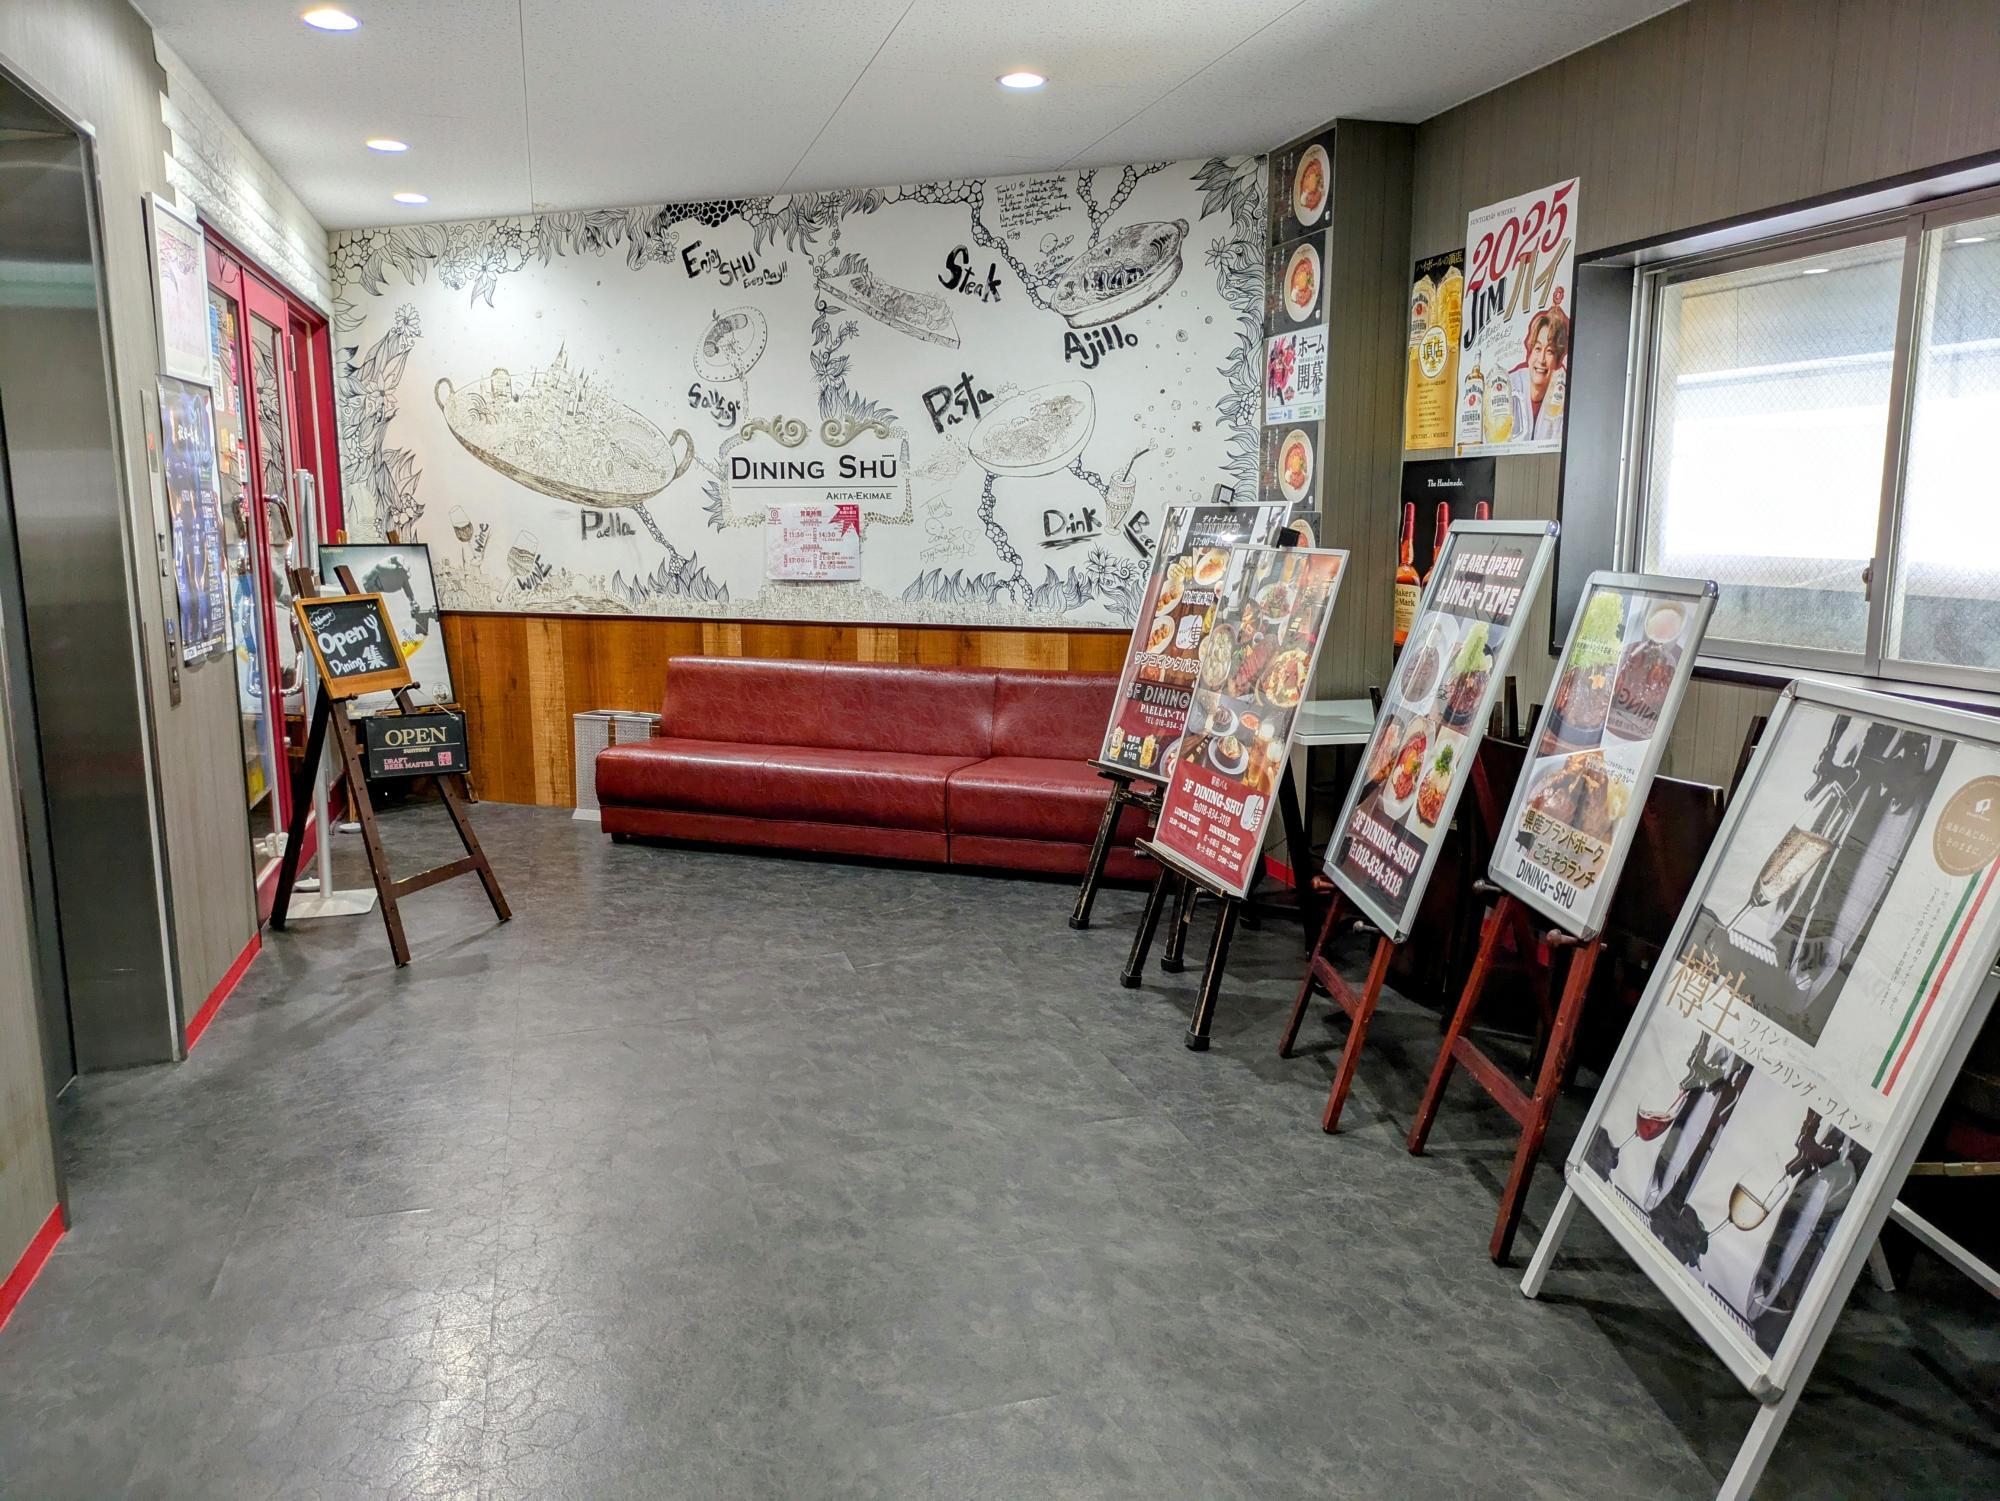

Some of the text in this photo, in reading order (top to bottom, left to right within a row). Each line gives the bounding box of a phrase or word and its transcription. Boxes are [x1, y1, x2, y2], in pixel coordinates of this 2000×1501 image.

[1467, 180, 1575, 297] 2025
[681, 240, 722, 278] Enjoy
[718, 251, 756, 287] SHU
[938, 244, 1001, 303] Steak
[1464, 276, 1507, 350] JIM
[1063, 324, 1138, 369] Ajillo
[1298, 334, 1325, 357] ホーム
[1297, 361, 1324, 391] 開幕
[921, 371, 995, 434] Pasta
[731, 456, 825, 480] DINING
[825, 491, 893, 500] AKITA-EKIMAE
[1043, 506, 1101, 537] Drink
[517, 554, 552, 591] WINE
[1454, 553, 1469, 571] WE
[1466, 554, 1489, 574] ARE
[318, 626, 369, 657] Open
[330, 657, 367, 675] Dining
[1127, 682, 1142, 699] 3F
[384, 726, 447, 746] OPEN
[404, 760, 435, 769] MASTER
[1182, 778, 1244, 818] 3F DINING-SHU
[1352, 809, 1420, 874] 3F DINING-SHU
[1516, 858, 1578, 910] DINING-SHU
[1533, 842, 1596, 890] ごちそうランチ
